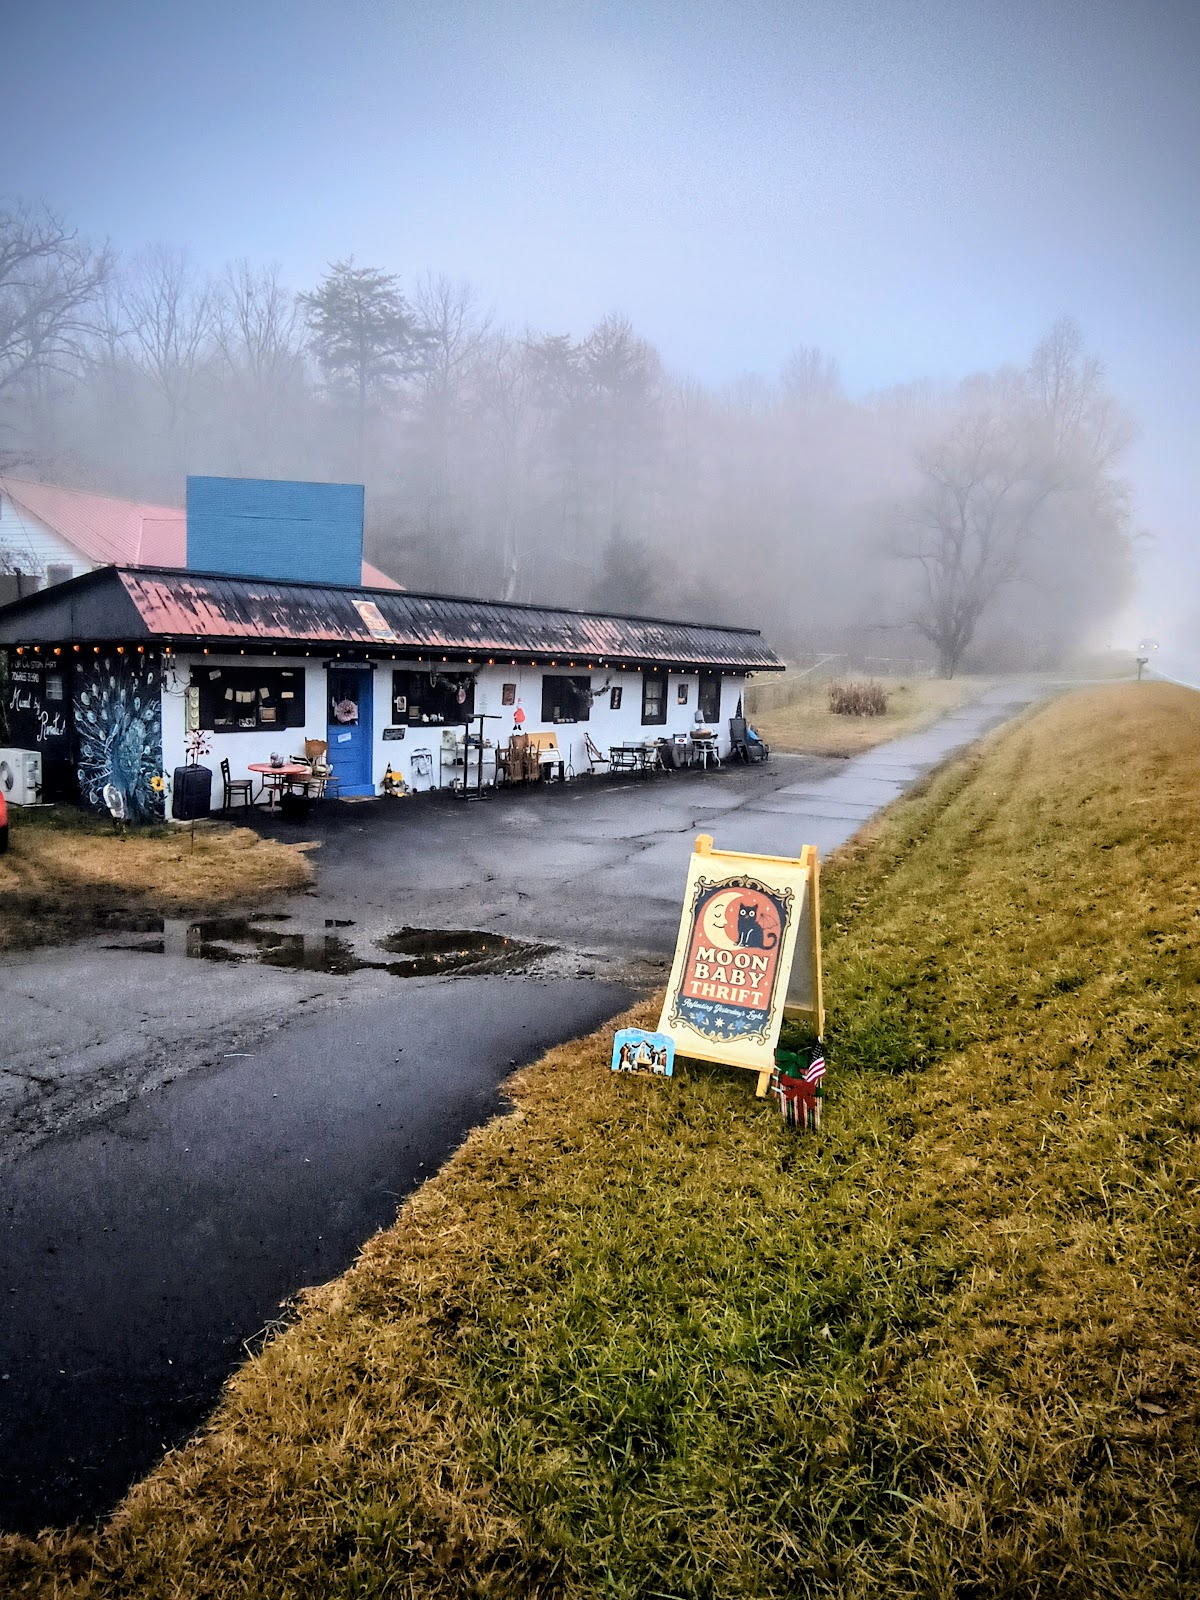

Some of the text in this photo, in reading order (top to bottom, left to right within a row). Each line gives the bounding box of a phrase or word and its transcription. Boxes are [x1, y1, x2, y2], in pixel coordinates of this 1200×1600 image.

[33, 697, 41, 716] by
[695, 946, 769, 972] MOON
[693, 963, 765, 989] BABY
[690, 981, 763, 1005] THRIFT
[681, 998, 713, 1012] Reflecting
[713, 1003, 745, 1017] Yesterday's
[745, 1010, 764, 1020] Light
